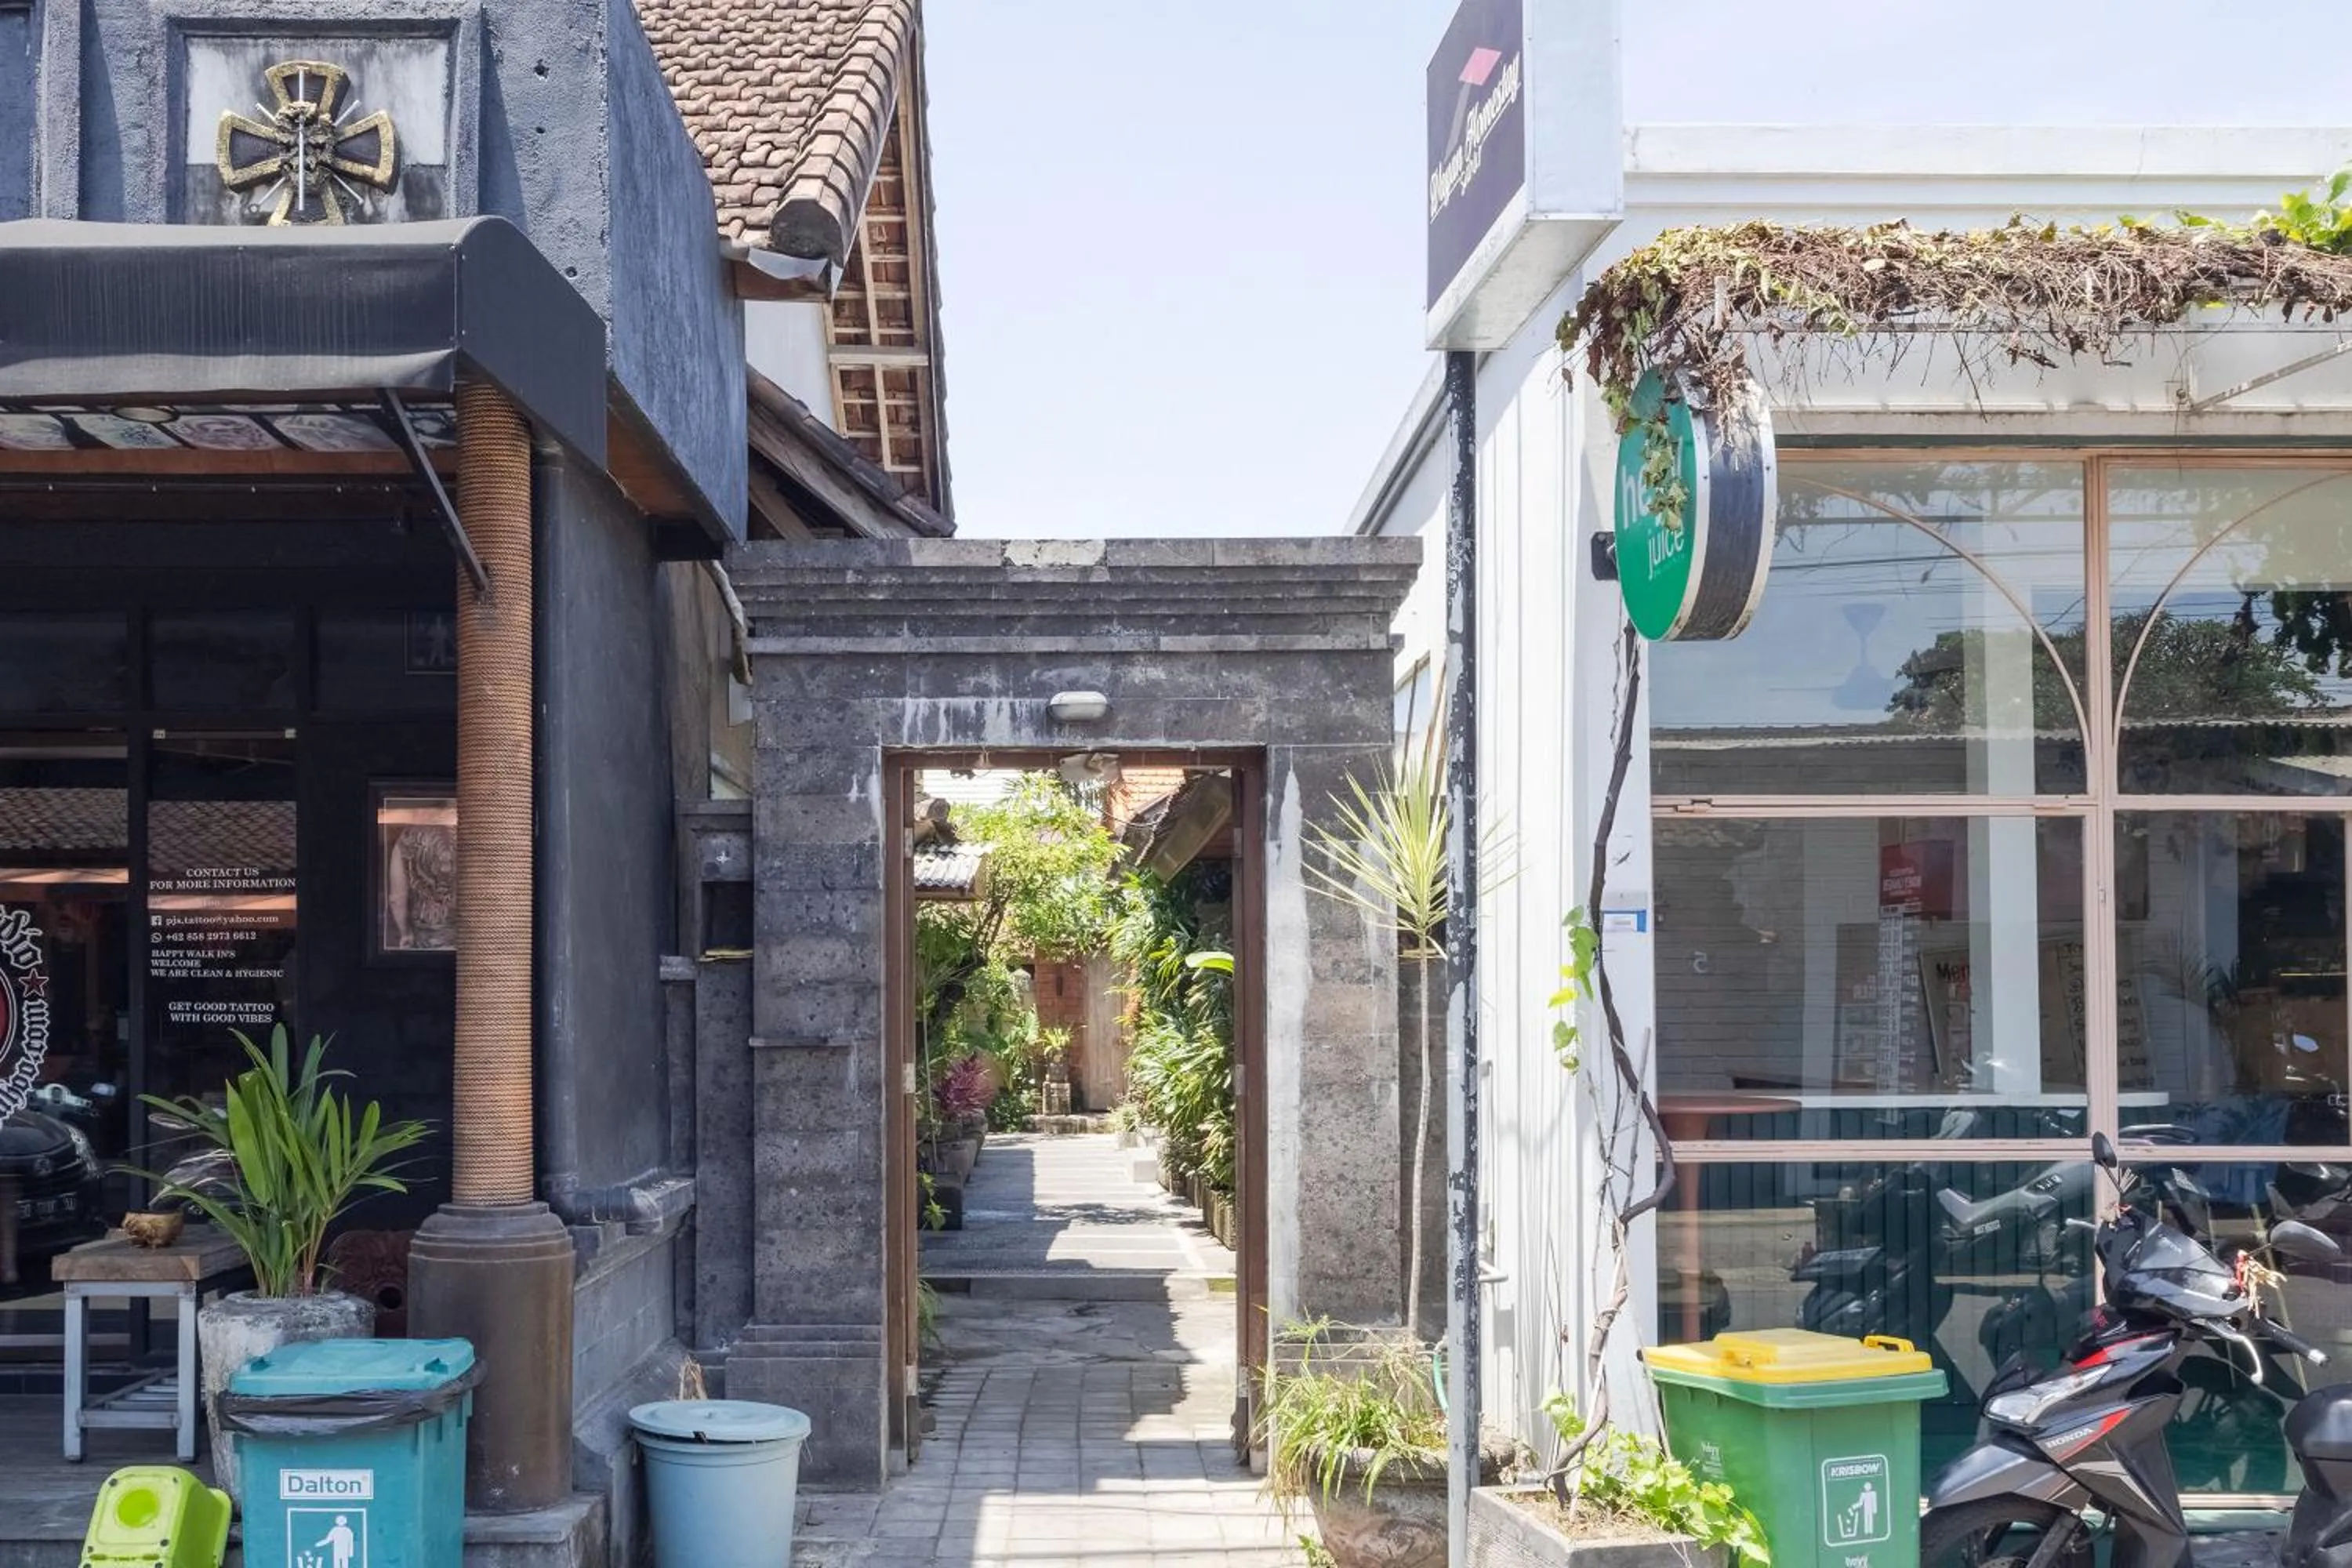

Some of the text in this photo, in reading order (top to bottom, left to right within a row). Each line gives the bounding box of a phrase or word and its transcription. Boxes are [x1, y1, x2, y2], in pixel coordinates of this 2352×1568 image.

[1465, 52, 1521, 161] Homestay
[1648, 517, 1685, 581] juice
[186, 867, 260, 877] CONTACT US
[150, 878, 296, 890] FOR MORE INFORMATION
[191, 969, 223, 978] CLEAN
[225, 969, 233, 978] &
[235, 969, 285, 978] HYGIENIC
[169, 1001, 274, 1012] GET GOOD TATTOO
[170, 1013, 273, 1023] WITH GOOD VIBES
[2045, 1427, 2096, 1449] HONDA
[1830, 1462, 1880, 1477] KRISBOW
[288, 1475, 362, 1494] Dalton
